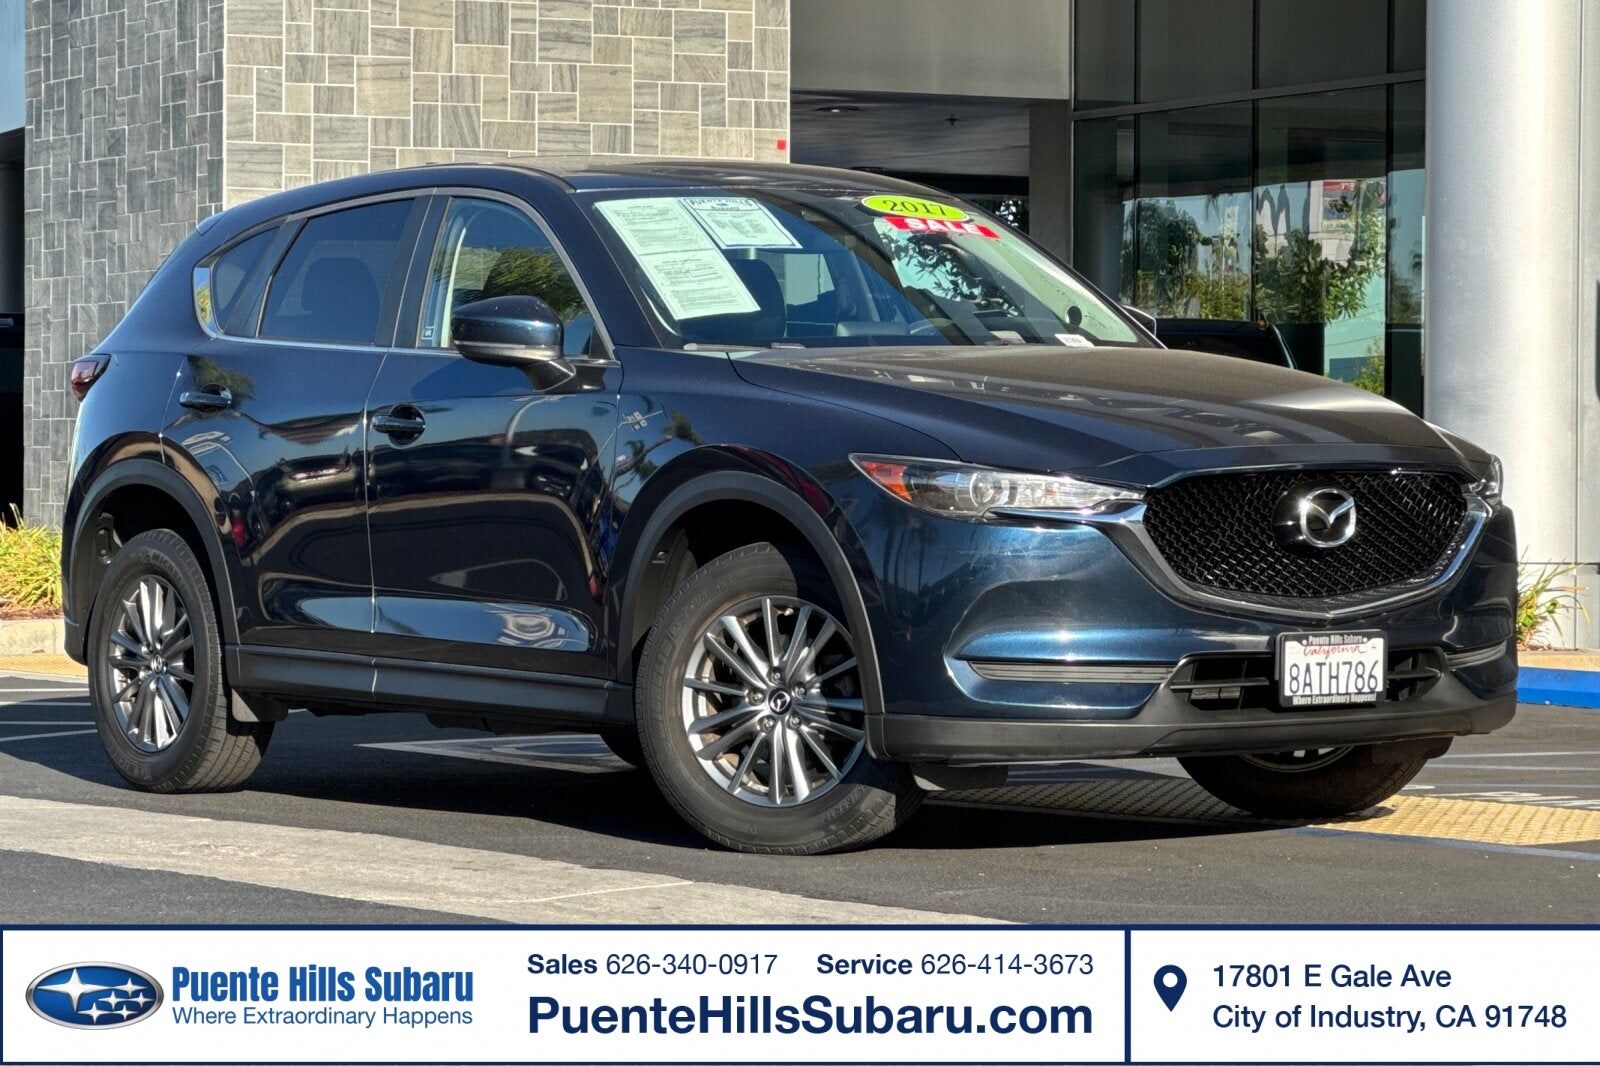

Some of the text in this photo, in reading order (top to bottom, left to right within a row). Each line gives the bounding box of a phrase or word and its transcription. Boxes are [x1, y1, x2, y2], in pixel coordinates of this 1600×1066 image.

[882, 199, 948, 217] 2017
[905, 218, 980, 235] SALE
[1308, 634, 1363, 645] Puente Hills Subaru
[1303, 645, 1367, 660] California
[1289, 660, 1379, 695] 8ATH786
[1292, 692, 1377, 706] Where Extraordinary Happens!
